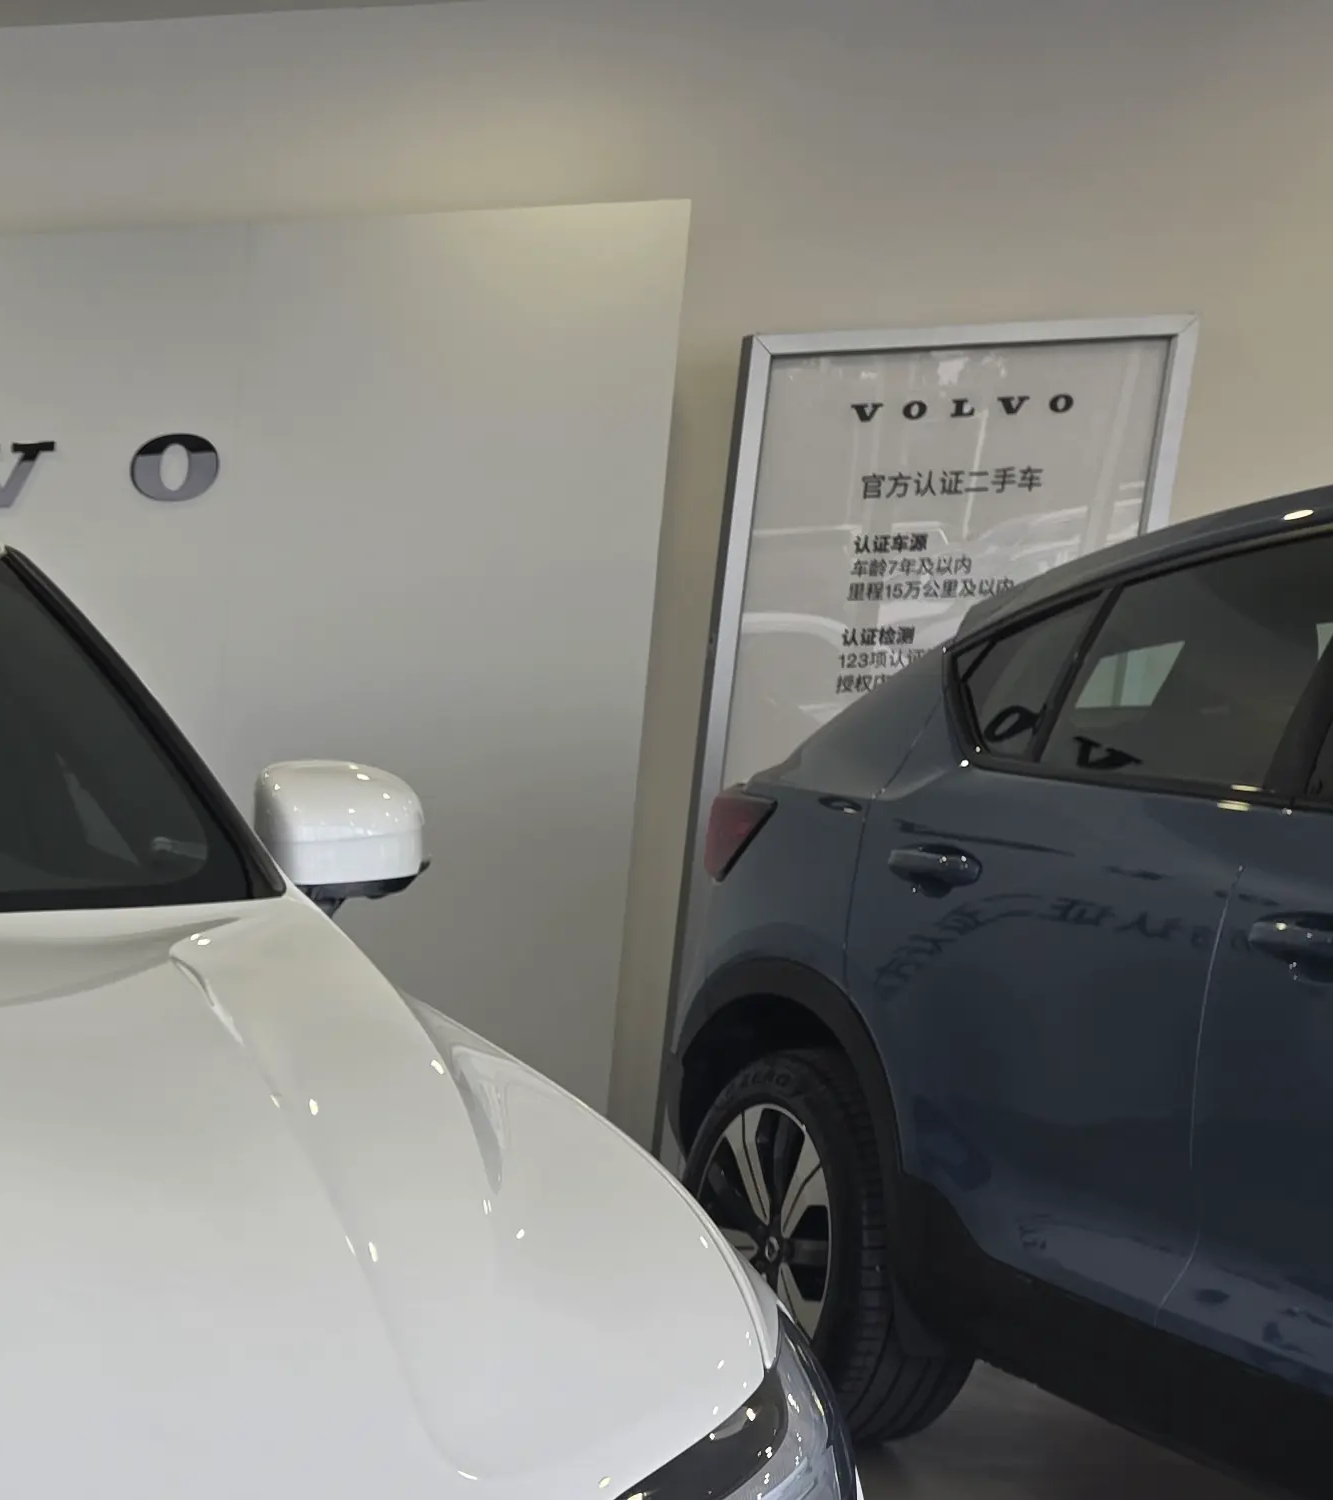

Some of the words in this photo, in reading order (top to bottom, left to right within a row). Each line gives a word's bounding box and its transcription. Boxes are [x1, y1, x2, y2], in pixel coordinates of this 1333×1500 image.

[850, 393, 1075, 423] VOLVO
[861, 465, 1044, 500] 官方认证二手车
[853, 532, 929, 555] 认证车源
[841, 625, 916, 647] 认证检测
